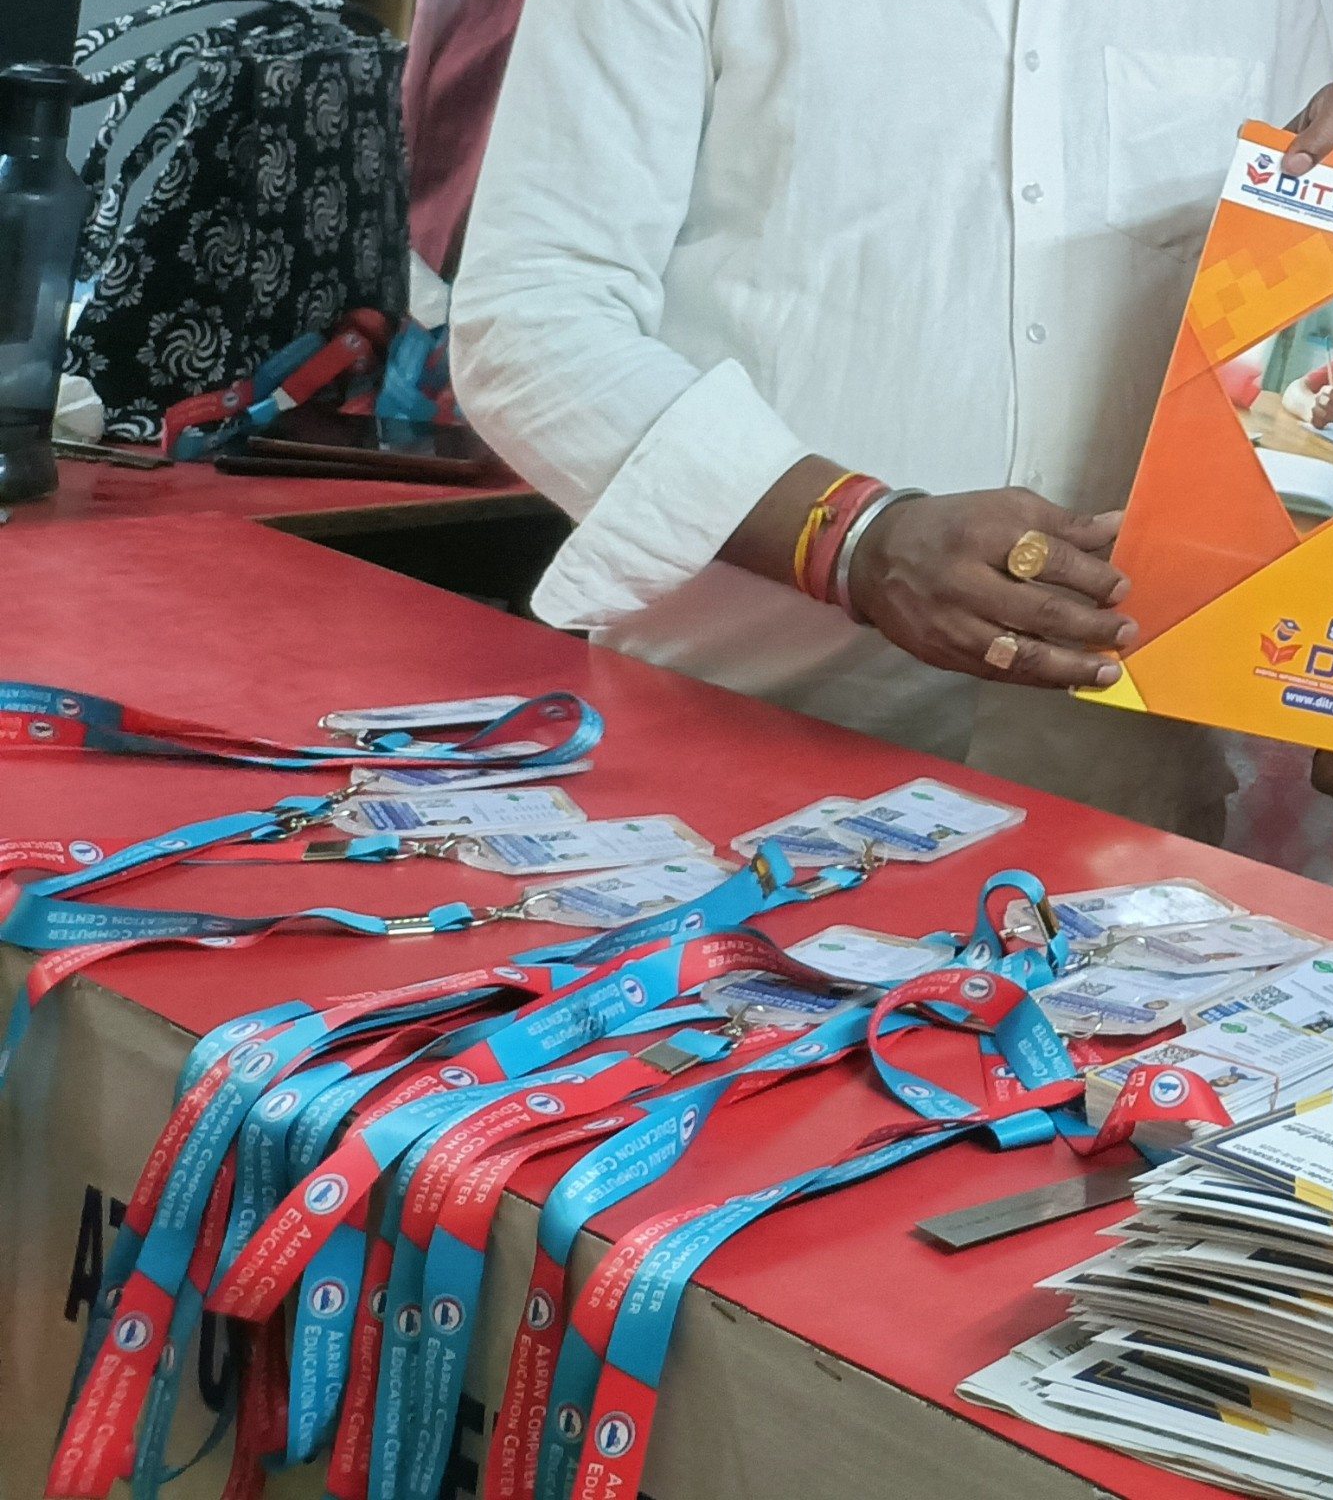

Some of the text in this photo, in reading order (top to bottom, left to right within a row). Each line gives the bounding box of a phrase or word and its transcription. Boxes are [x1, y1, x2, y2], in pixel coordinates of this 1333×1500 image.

[411, 1102, 523, 1214] EDUCATION CENTER
[428, 1135, 486, 1212] COMPUTER
[564, 1116, 677, 1200] EDUCATION CENTER
[584, 1160, 649, 1204] COMPUTER
[239, 1207, 303, 1288] EDUCATION
[588, 1247, 636, 1309] CENTER
[629, 1250, 672, 1316] CENTER
[650, 1233, 711, 1313] COMPUTER
[535, 1343, 551, 1398] AARAV
[500, 1334, 532, 1497] EDUCATION CENTER
